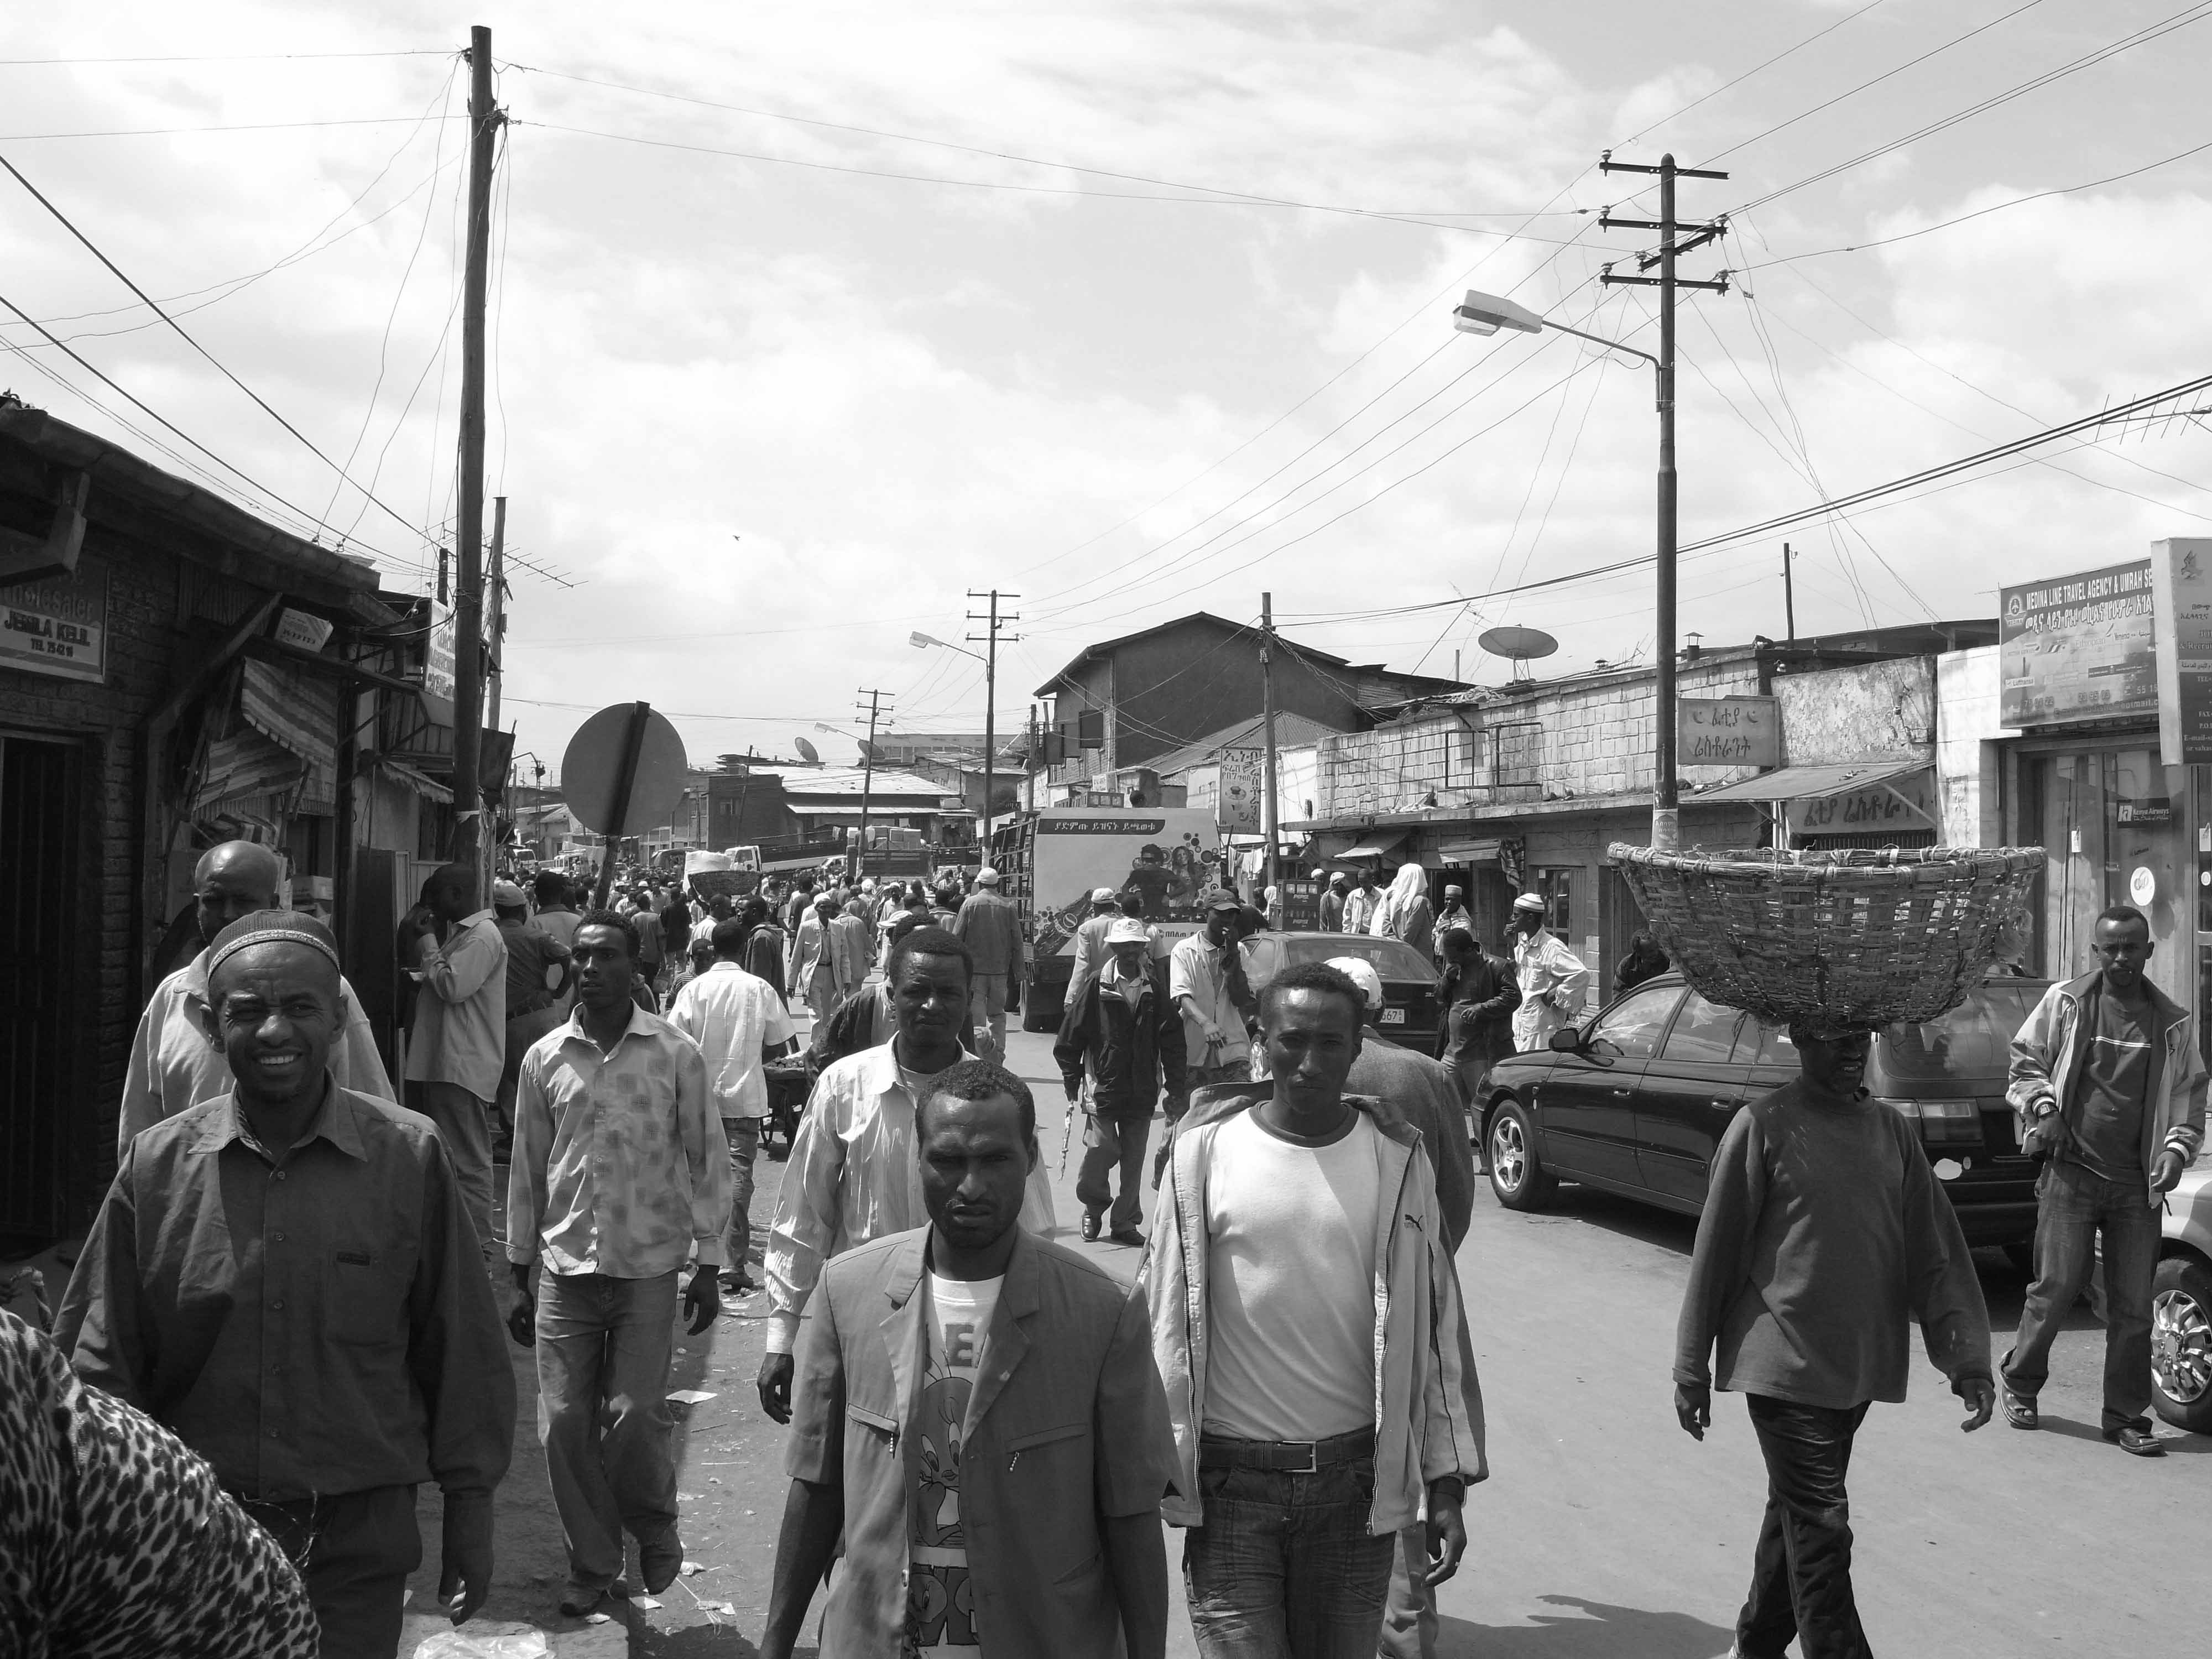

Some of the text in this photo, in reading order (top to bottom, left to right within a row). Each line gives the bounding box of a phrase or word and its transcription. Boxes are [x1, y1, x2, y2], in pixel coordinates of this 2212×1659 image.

[2026, 589, 2048, 611] MEDINA
[2049, 587, 2062, 606] LINE
[2063, 582, 2086, 603] TRAVEL
[2087, 576, 2112, 599] AGENCY
[2114, 575, 2118, 594] &
[2120, 571, 2142, 592] UMRAH
